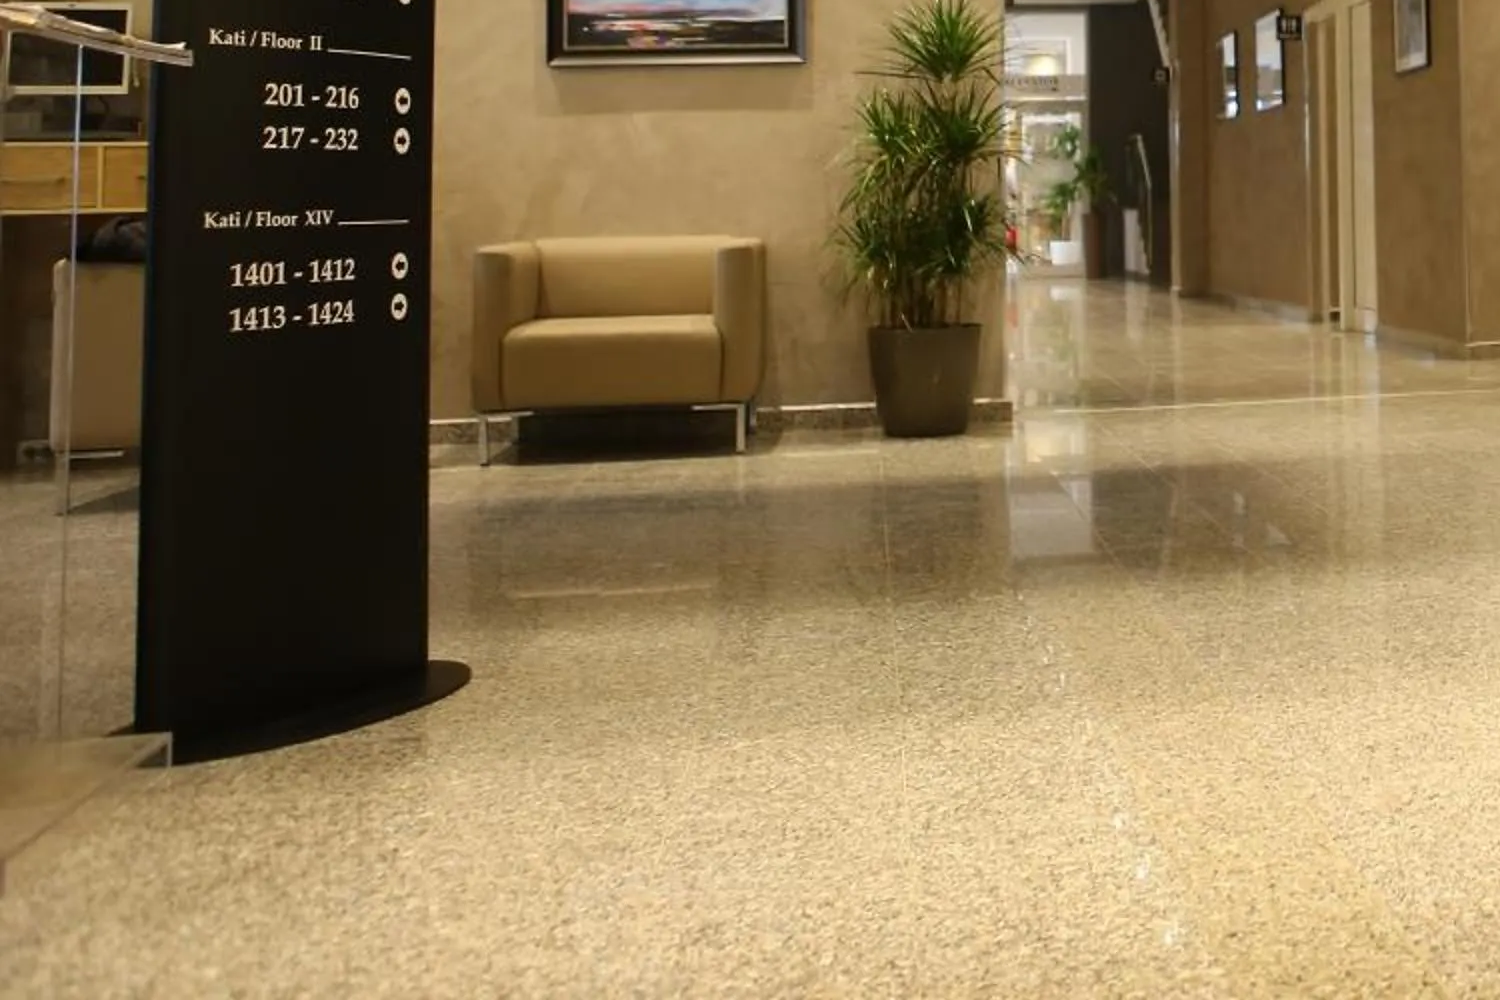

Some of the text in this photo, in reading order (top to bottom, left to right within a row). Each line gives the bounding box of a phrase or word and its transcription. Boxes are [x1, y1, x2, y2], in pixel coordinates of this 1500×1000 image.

[208, 28, 246, 47] Kati
[261, 31, 303, 50] Floor
[309, 35, 323, 51] II
[264, 83, 305, 107] 201
[325, 85, 360, 109] 216
[262, 126, 305, 149] 217
[324, 128, 359, 150] 232
[203, 211, 241, 229] Kati
[255, 211, 299, 228] Floor
[304, 209, 335, 225] XIV
[229, 261, 287, 287] 1401
[308, 257, 356, 283] 1412
[228, 305, 287, 332] 1413
[307, 299, 355, 326] 1424
